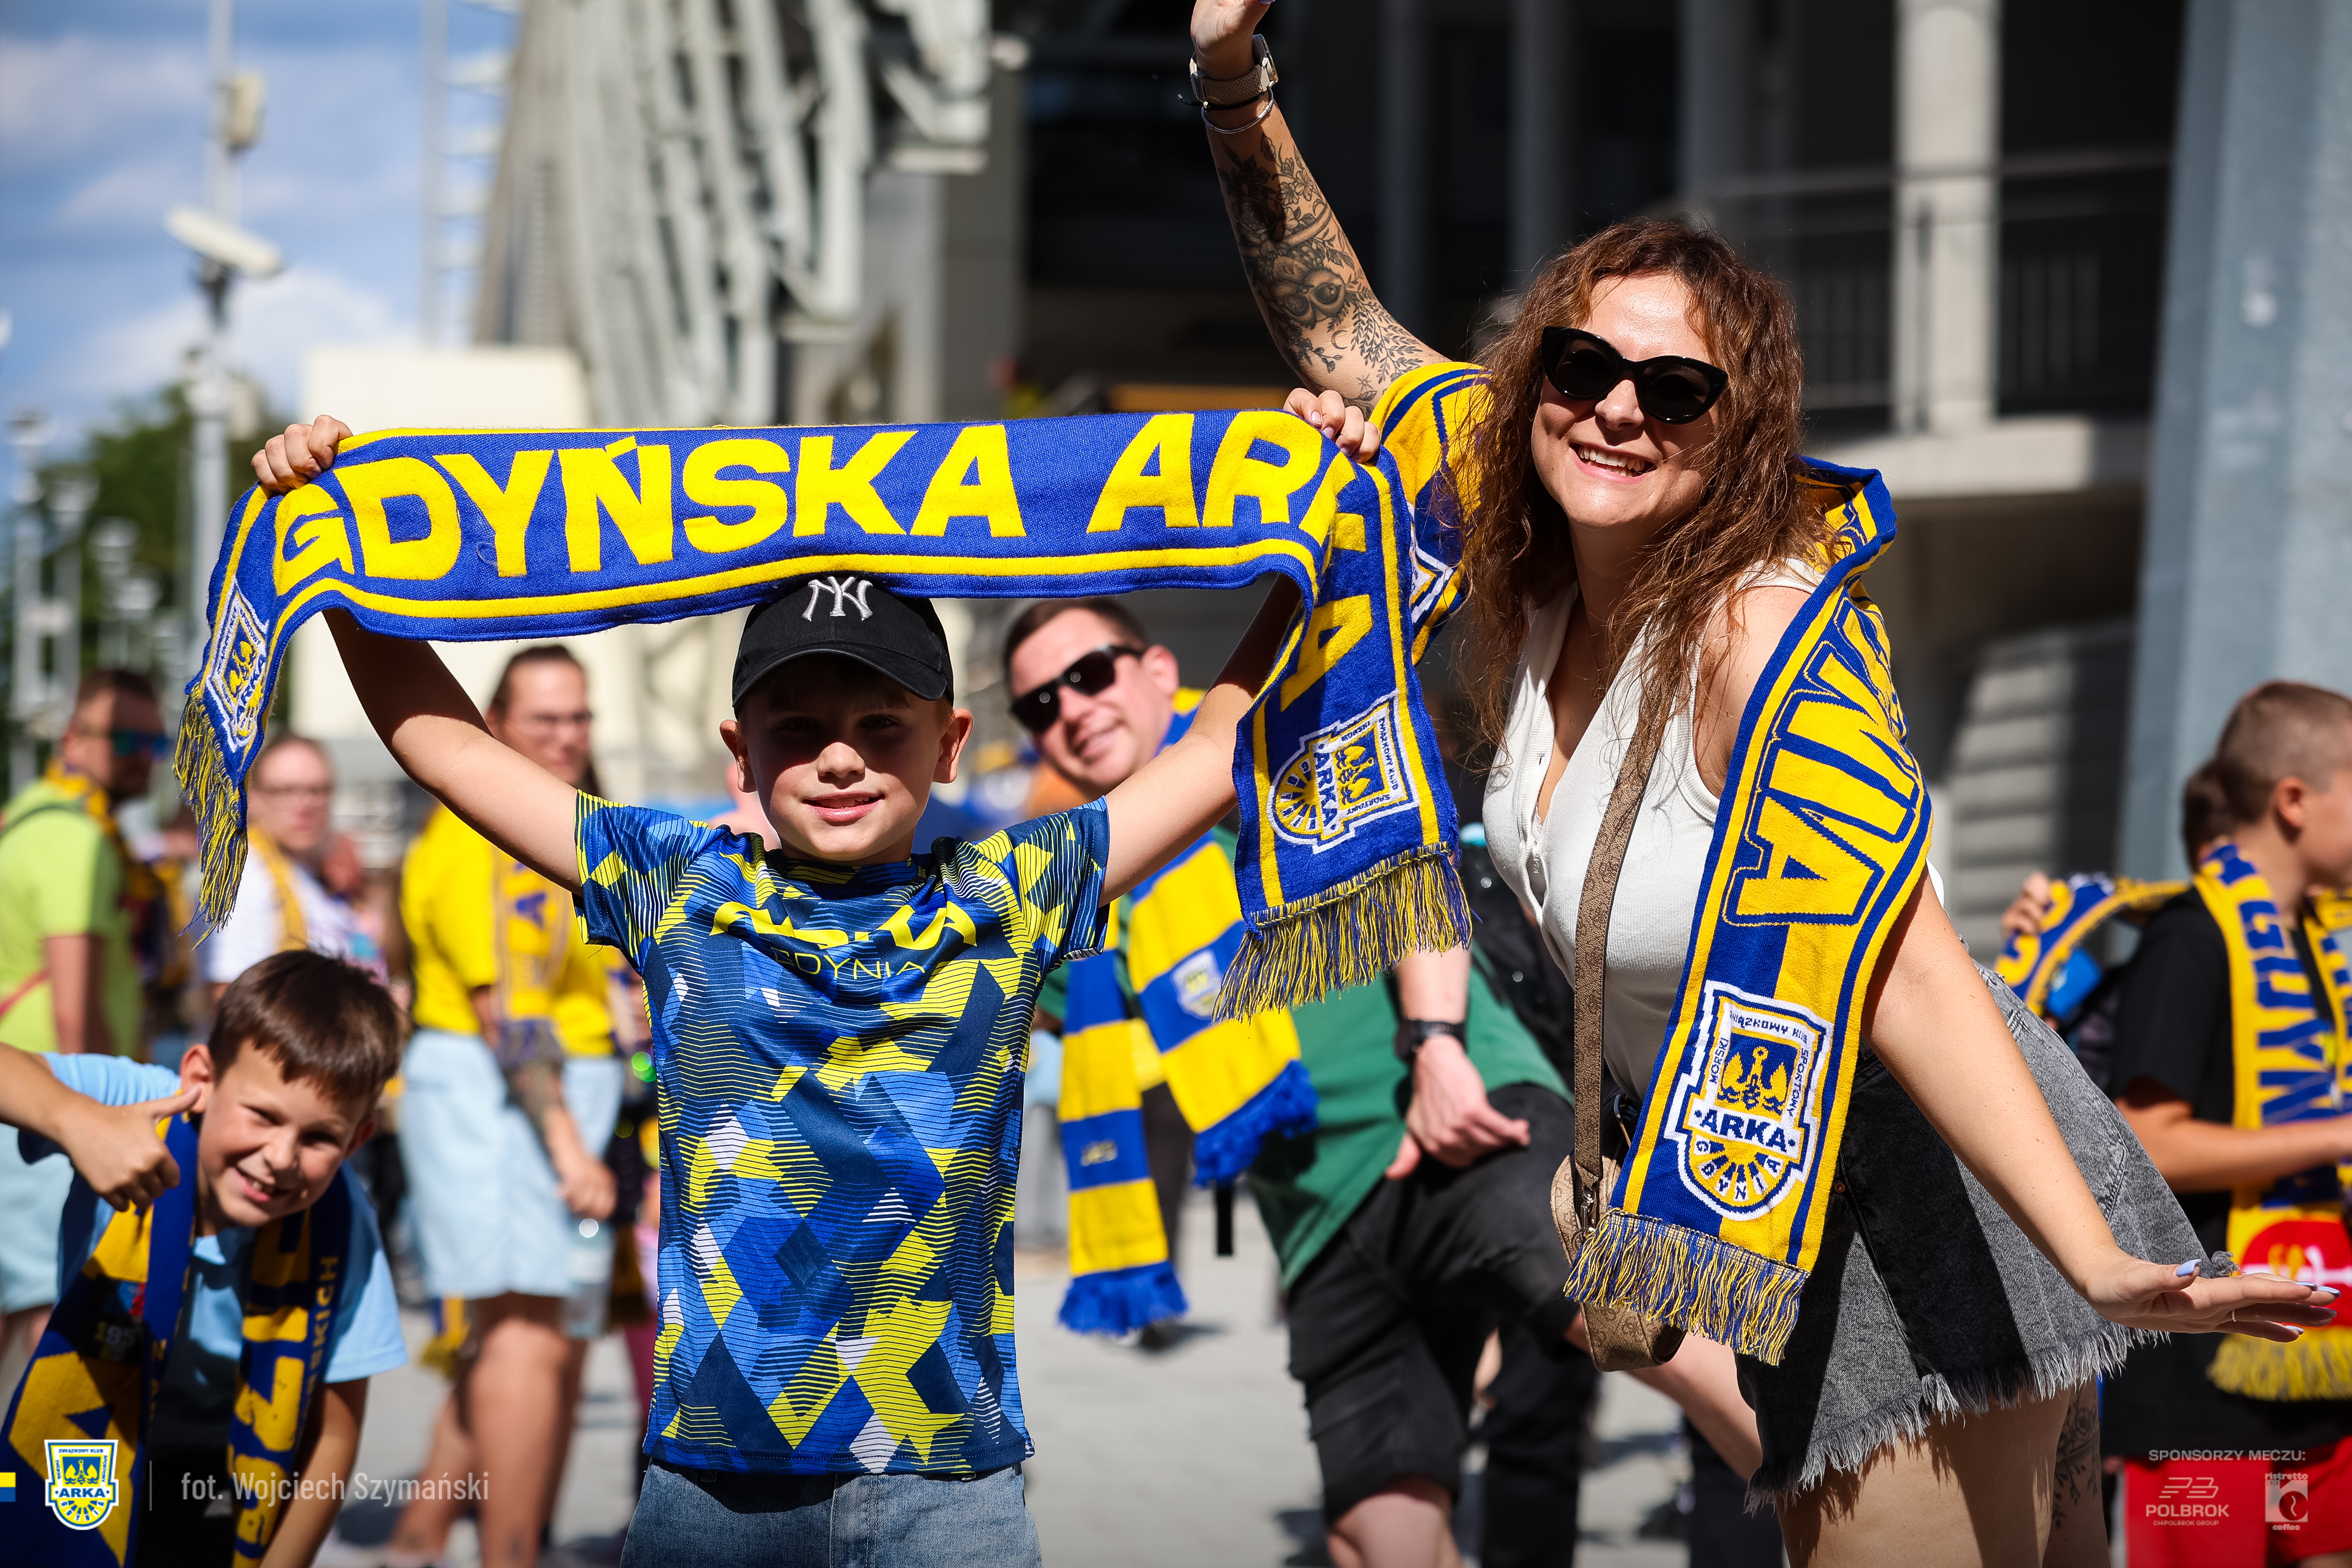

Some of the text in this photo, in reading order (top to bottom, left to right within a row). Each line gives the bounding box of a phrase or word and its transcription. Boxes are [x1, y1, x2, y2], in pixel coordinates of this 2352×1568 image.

[273, 424, 1026, 595] GDYŃSKA
[801, 576, 873, 622] NY
[1314, 753, 1338, 827] ARKA
[1709, 1037, 1730, 1084] MORSKI
[1787, 1047, 1809, 1116] SPORTOWY
[1698, 1109, 1788, 1154] ARKA
